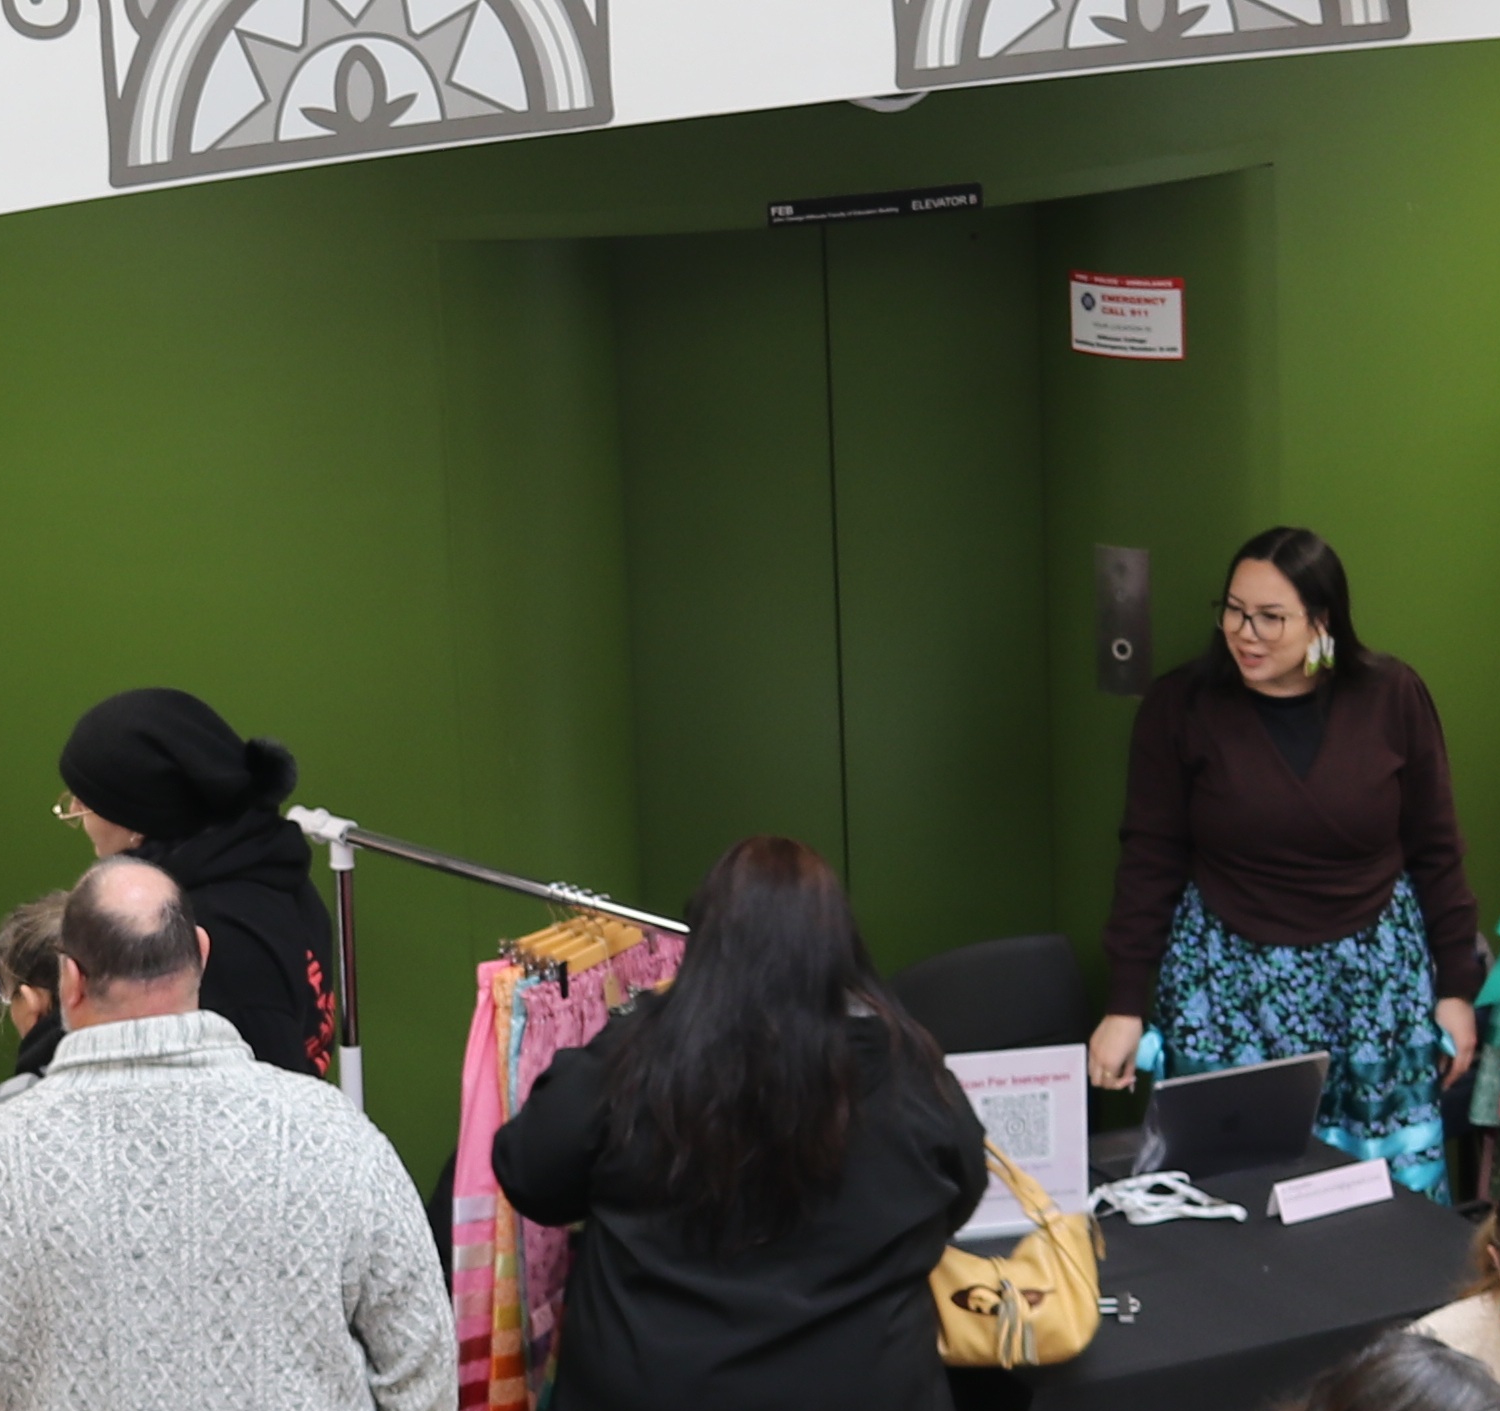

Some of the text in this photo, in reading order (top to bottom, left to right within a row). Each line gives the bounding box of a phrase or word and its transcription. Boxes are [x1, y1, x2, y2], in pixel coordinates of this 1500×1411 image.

[911, 196, 967, 211] ELEVATOR
[770, 205, 794, 217] FEB
[1101, 294, 1166, 305] EMERGENCY
[1101, 306, 1149, 317] CALL 911
[1012, 1072, 1070, 1088] Instagram
